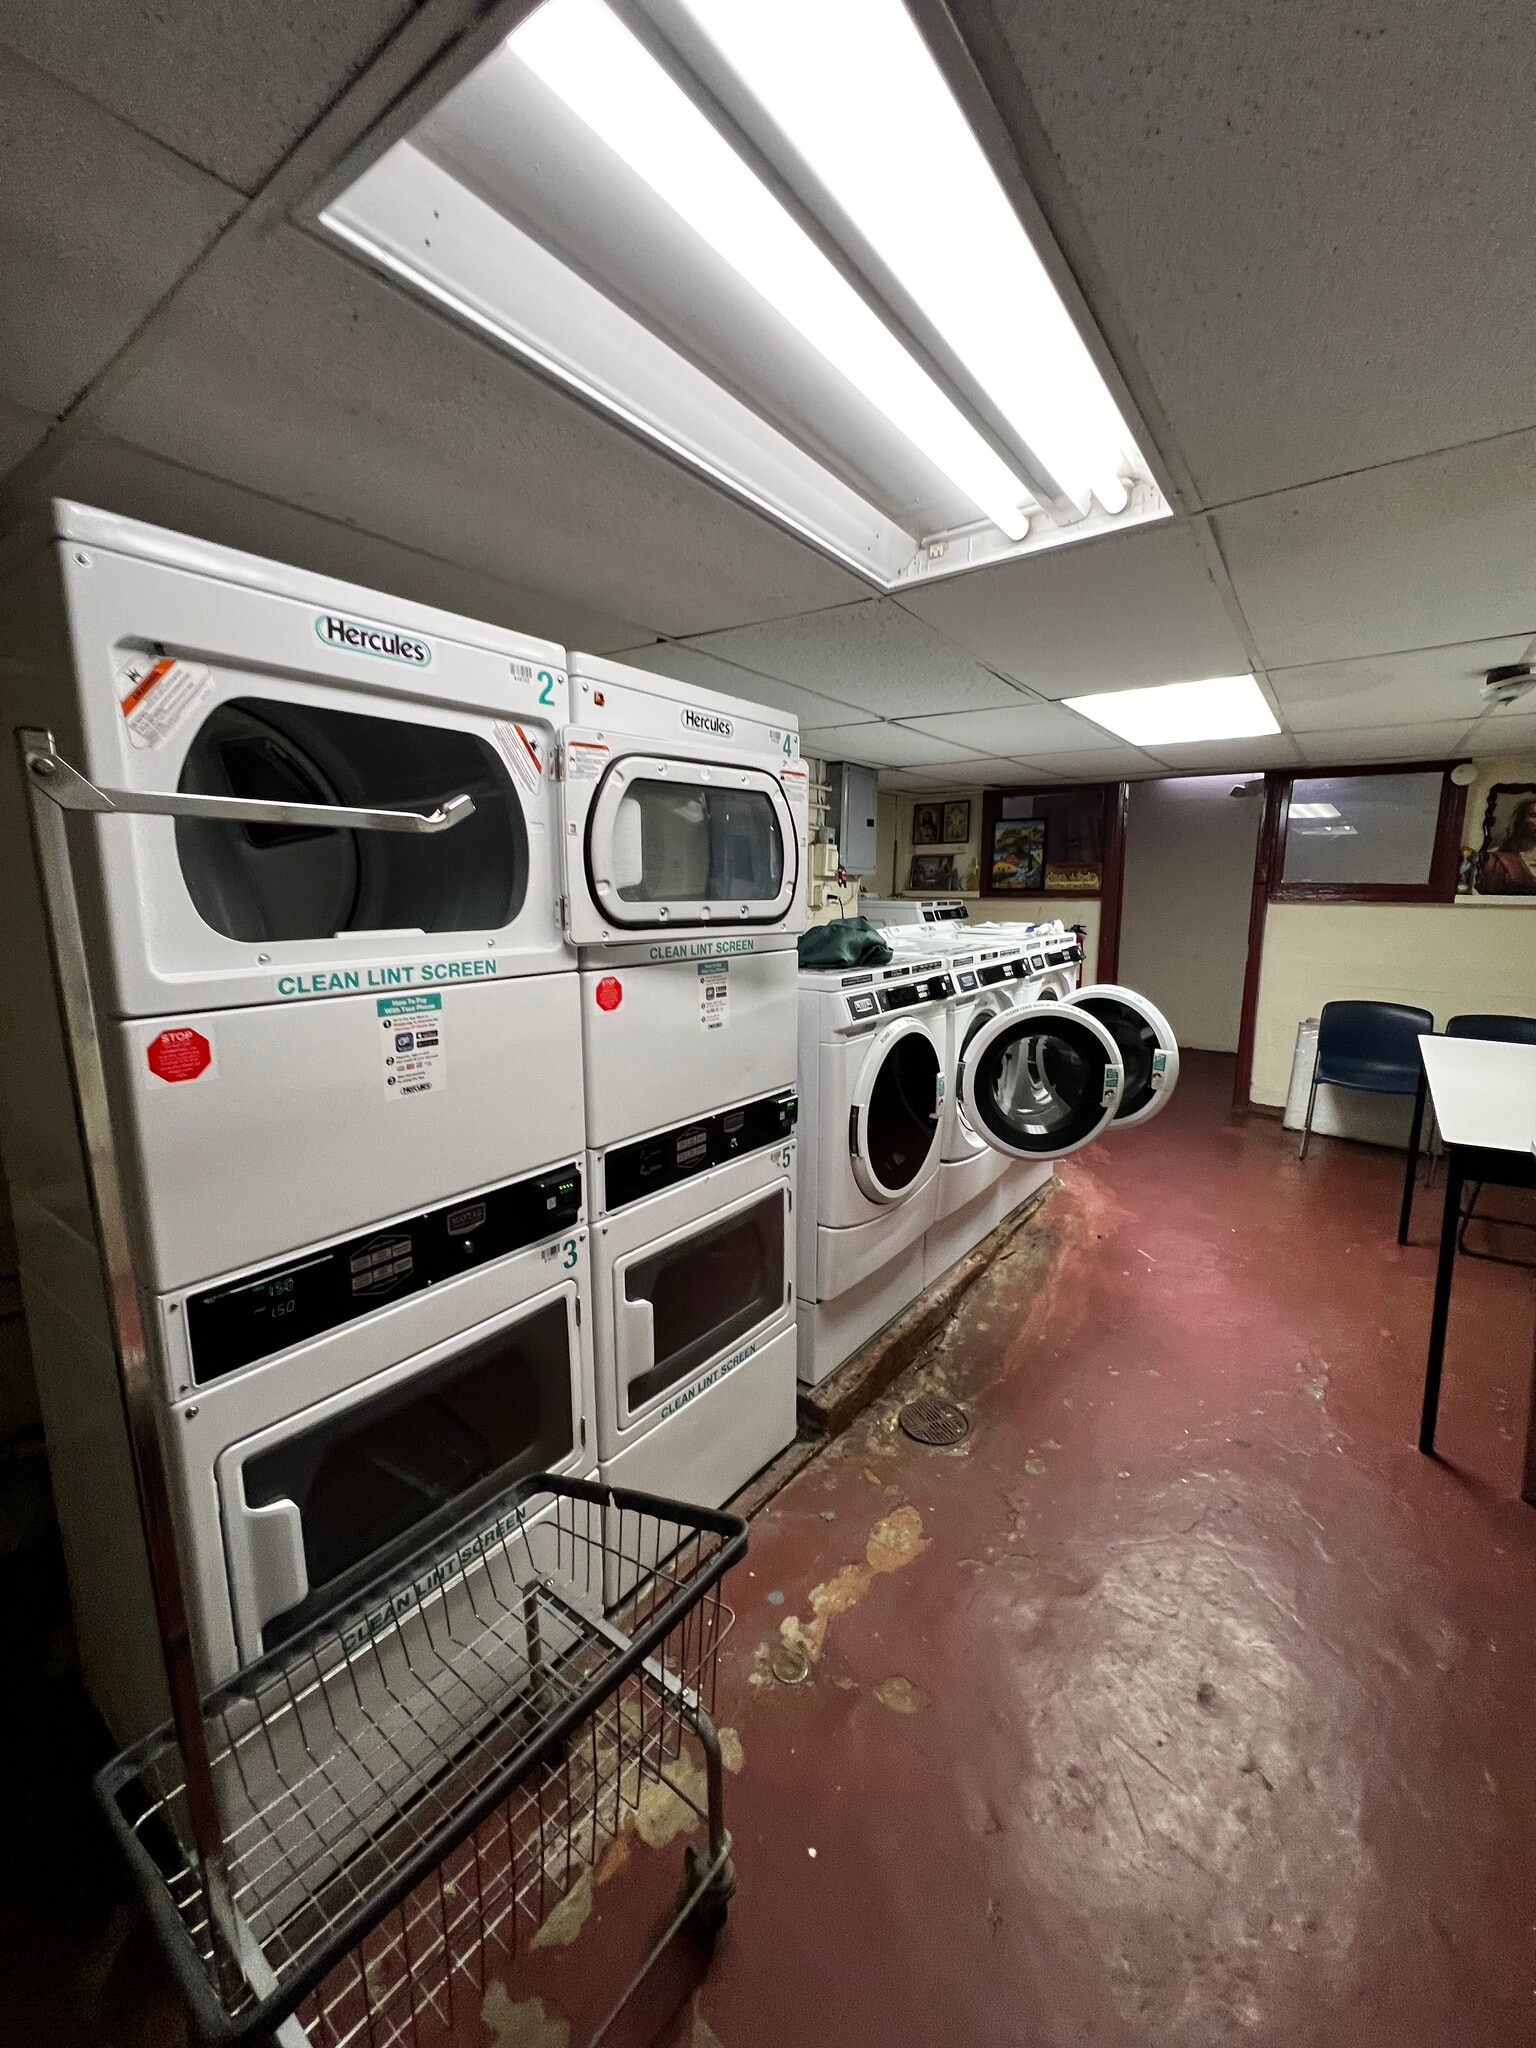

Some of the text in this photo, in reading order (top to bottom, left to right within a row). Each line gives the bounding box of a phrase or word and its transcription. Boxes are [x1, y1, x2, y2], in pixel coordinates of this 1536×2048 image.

[325, 615, 425, 661] Hercules
[537, 671, 555, 706] 2
[685, 709, 731, 735] Hercules
[782, 733, 792, 758] 4
[649, 939, 754, 960] CLEAN LINT SCREEN
[277, 959, 497, 995] CLEAN LINT SCREEN
[161, 1031, 193, 1043] STOP
[783, 1146, 790, 1168] 5
[563, 1239, 578, 1269] 3
[661, 1343, 757, 1419] CLEAN LINT SCREEN
[345, 1506, 526, 1650] CLEAN LINT SCREEN
